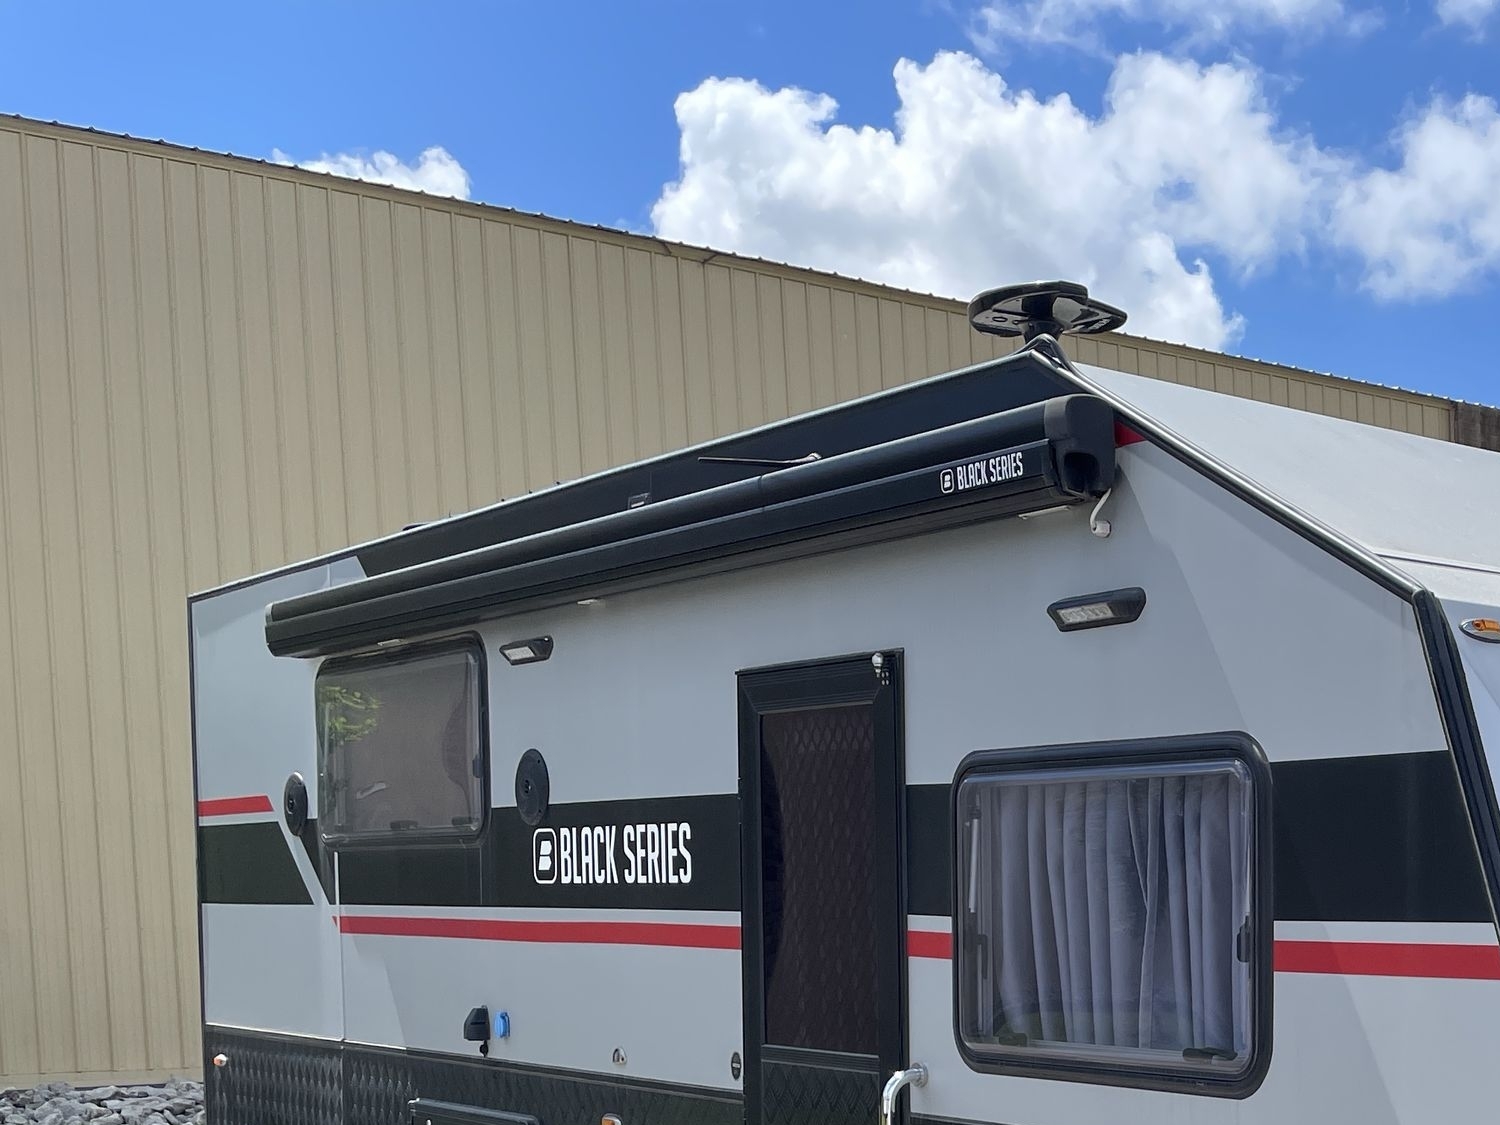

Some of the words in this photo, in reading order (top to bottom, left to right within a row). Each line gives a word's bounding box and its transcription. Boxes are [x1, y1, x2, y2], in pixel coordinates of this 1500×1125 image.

[956, 460, 988, 490] BLACK
[989, 451, 1024, 482] SERIES
[559, 825, 619, 884] BLACK
[623, 822, 692, 884] SERIES
